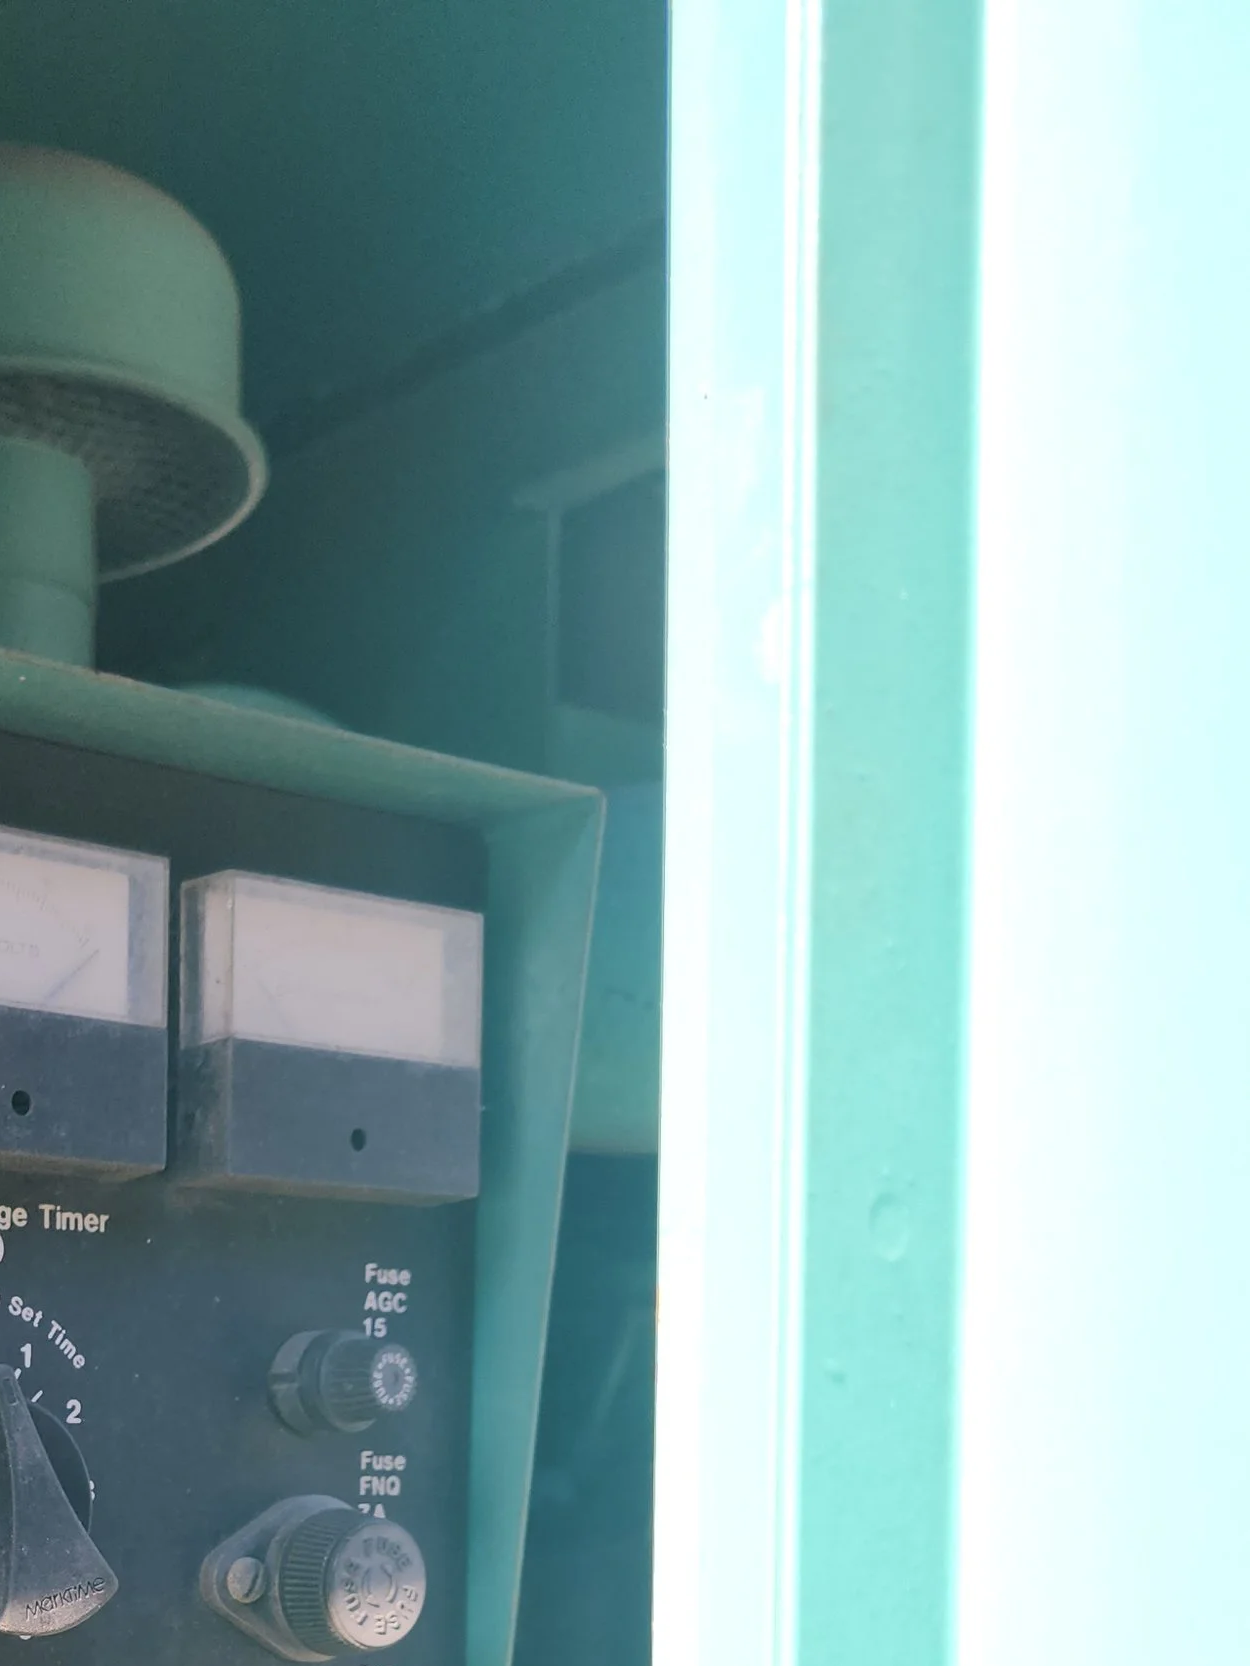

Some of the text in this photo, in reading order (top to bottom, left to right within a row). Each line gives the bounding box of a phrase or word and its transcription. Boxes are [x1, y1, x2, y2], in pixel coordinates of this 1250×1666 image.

[39, 1204, 109, 1233] Timer
[365, 1263, 411, 1286] Fuse
[363, 1291, 407, 1313] AGC
[8, 1296, 43, 1327] Set
[48, 1320, 85, 1369] Time
[363, 1317, 387, 1338] 15
[20, 1343, 32, 1368] 1
[66, 1399, 82, 1424] 2
[360, 1450, 406, 1471] Fuse
[359, 1476, 401, 1496] FNQ
